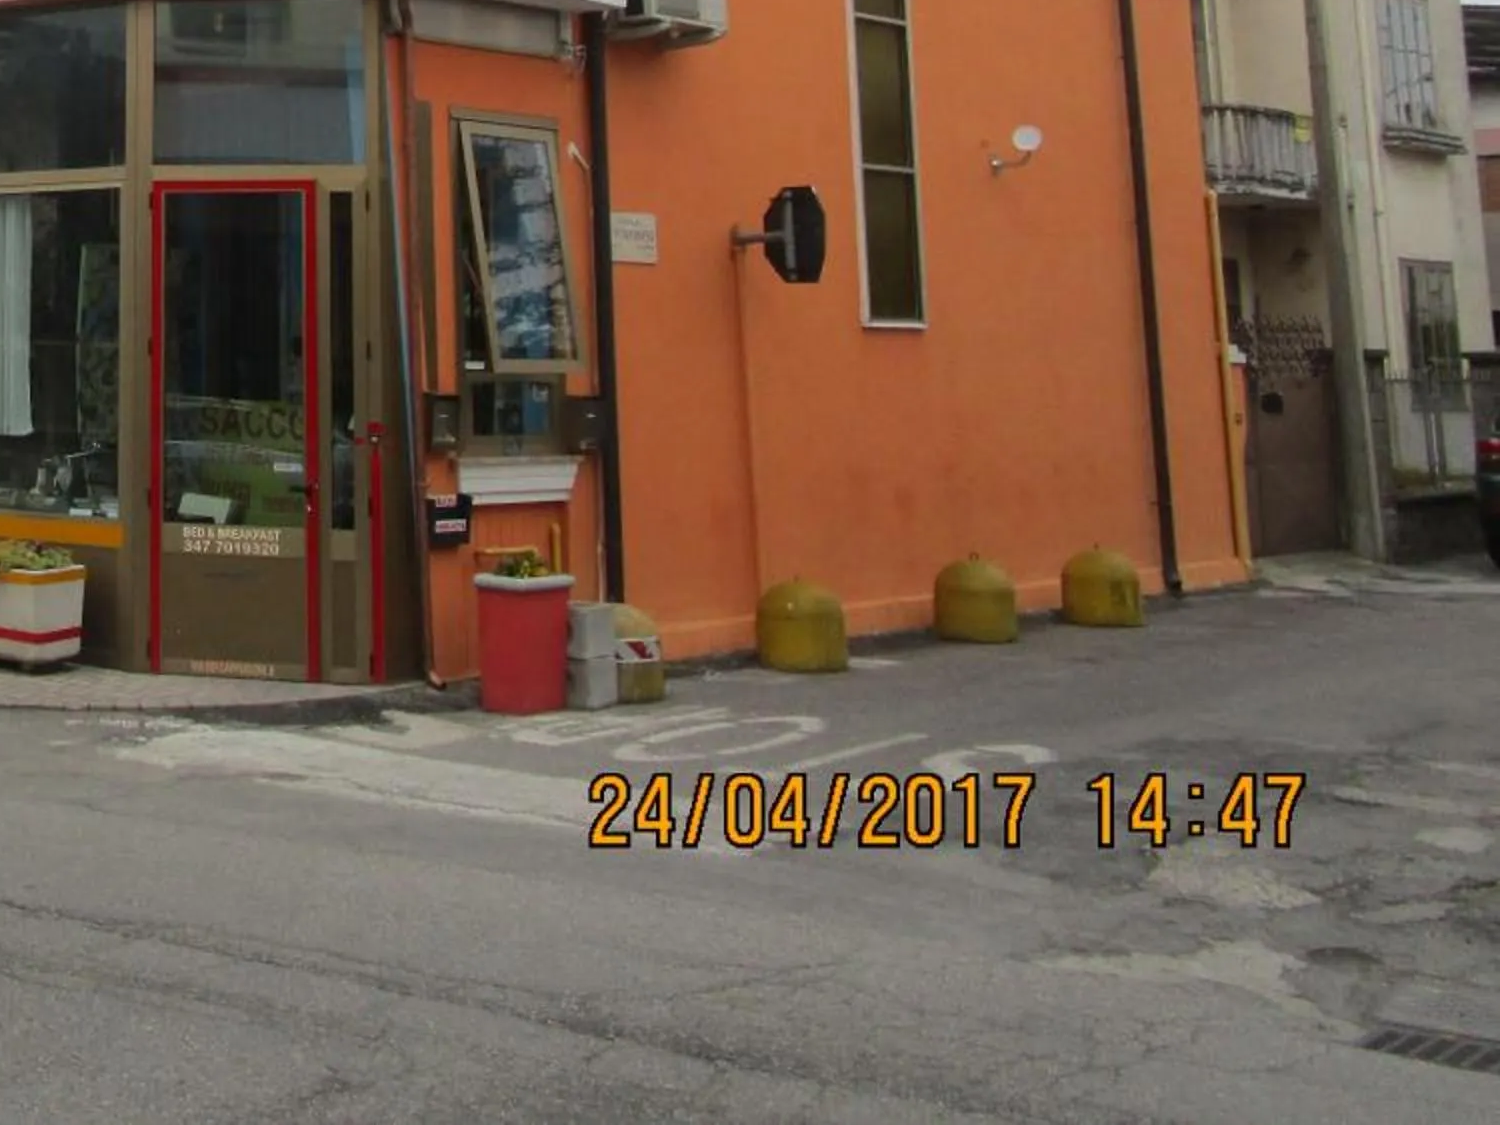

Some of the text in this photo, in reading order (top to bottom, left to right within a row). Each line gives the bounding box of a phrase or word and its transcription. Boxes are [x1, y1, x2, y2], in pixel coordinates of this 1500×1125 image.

[183, 526, 205, 538] BED
[217, 528, 281, 541] BREAKFAST
[182, 540, 210, 554] 347
